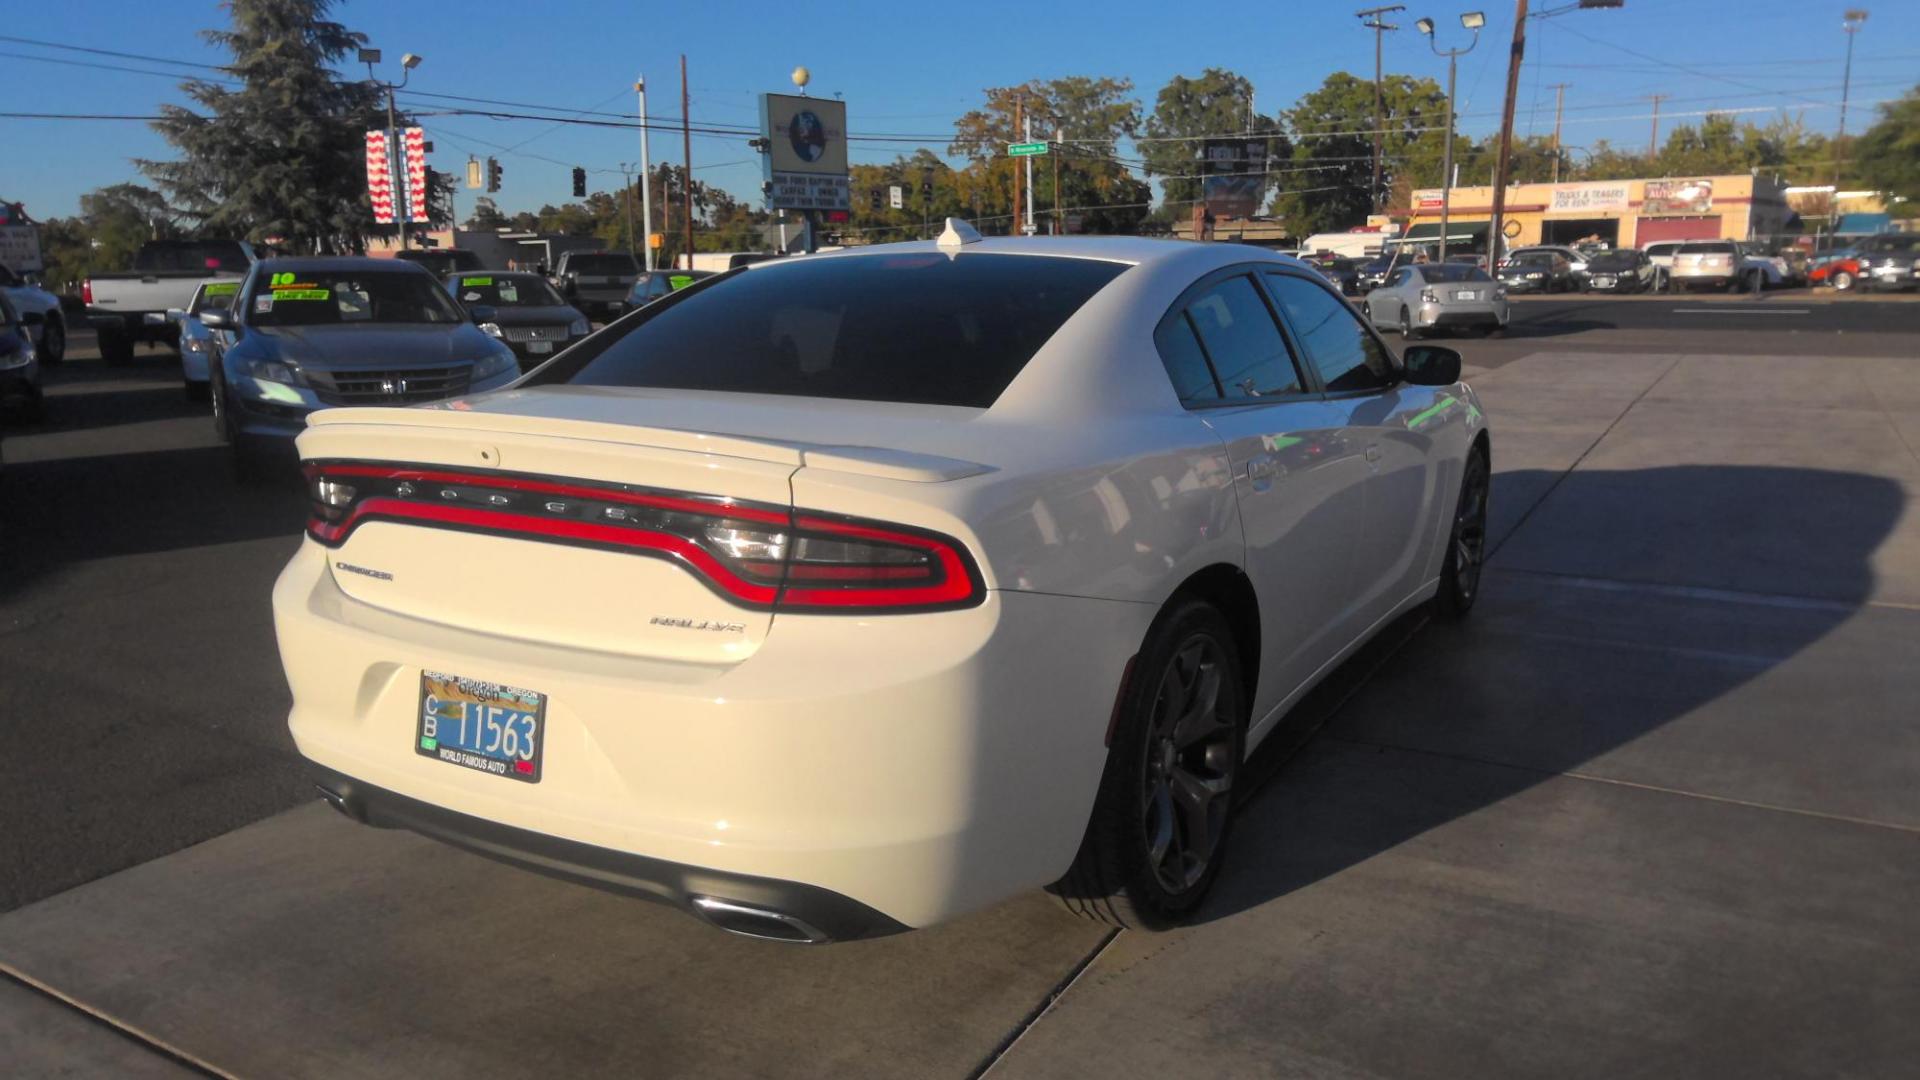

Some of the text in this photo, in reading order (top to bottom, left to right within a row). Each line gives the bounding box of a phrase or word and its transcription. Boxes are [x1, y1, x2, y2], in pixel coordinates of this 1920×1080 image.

[396, 481, 626, 520] DODGE
[506, 686, 539, 699] OREGON
[458, 701, 537, 761] 11563
[440, 748, 505, 774] WORLD FAMOUS AUTO
